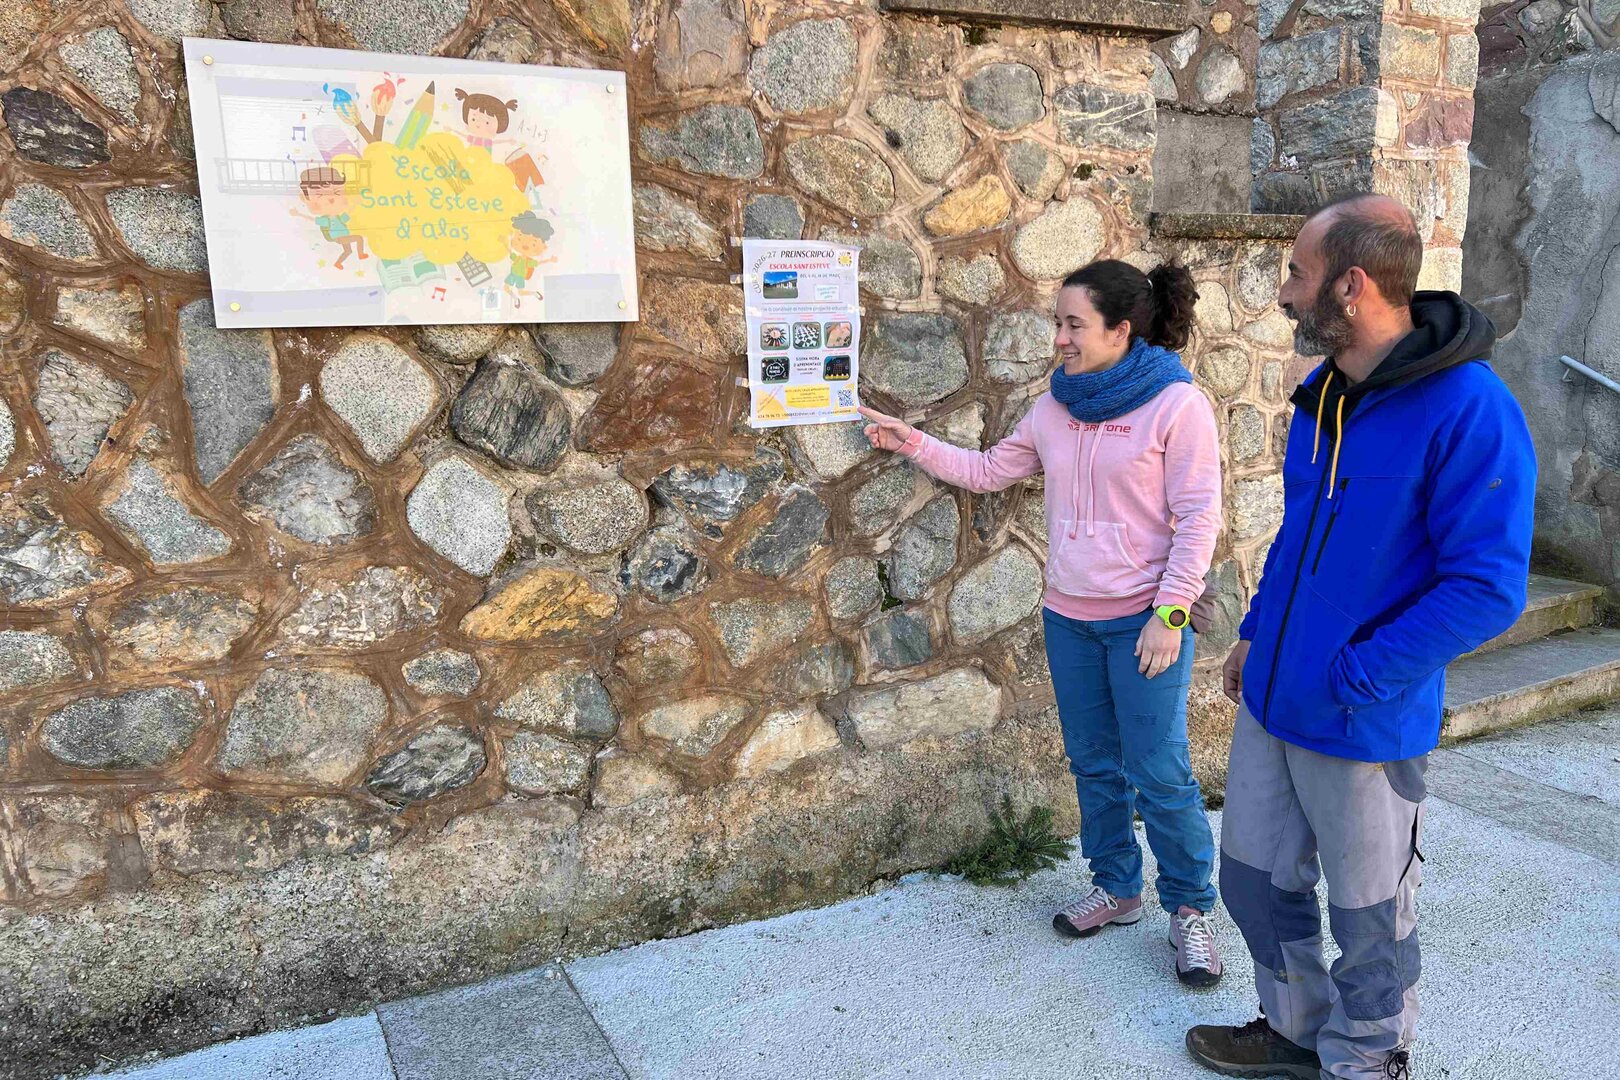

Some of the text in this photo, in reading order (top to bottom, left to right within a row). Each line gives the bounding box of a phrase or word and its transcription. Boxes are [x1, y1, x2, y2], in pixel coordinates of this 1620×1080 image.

[391, 155, 471, 181] Escola
[360, 187, 504, 213] Sant Esteve
[780, 249, 834, 258] PREINSCRIPCIÓ
